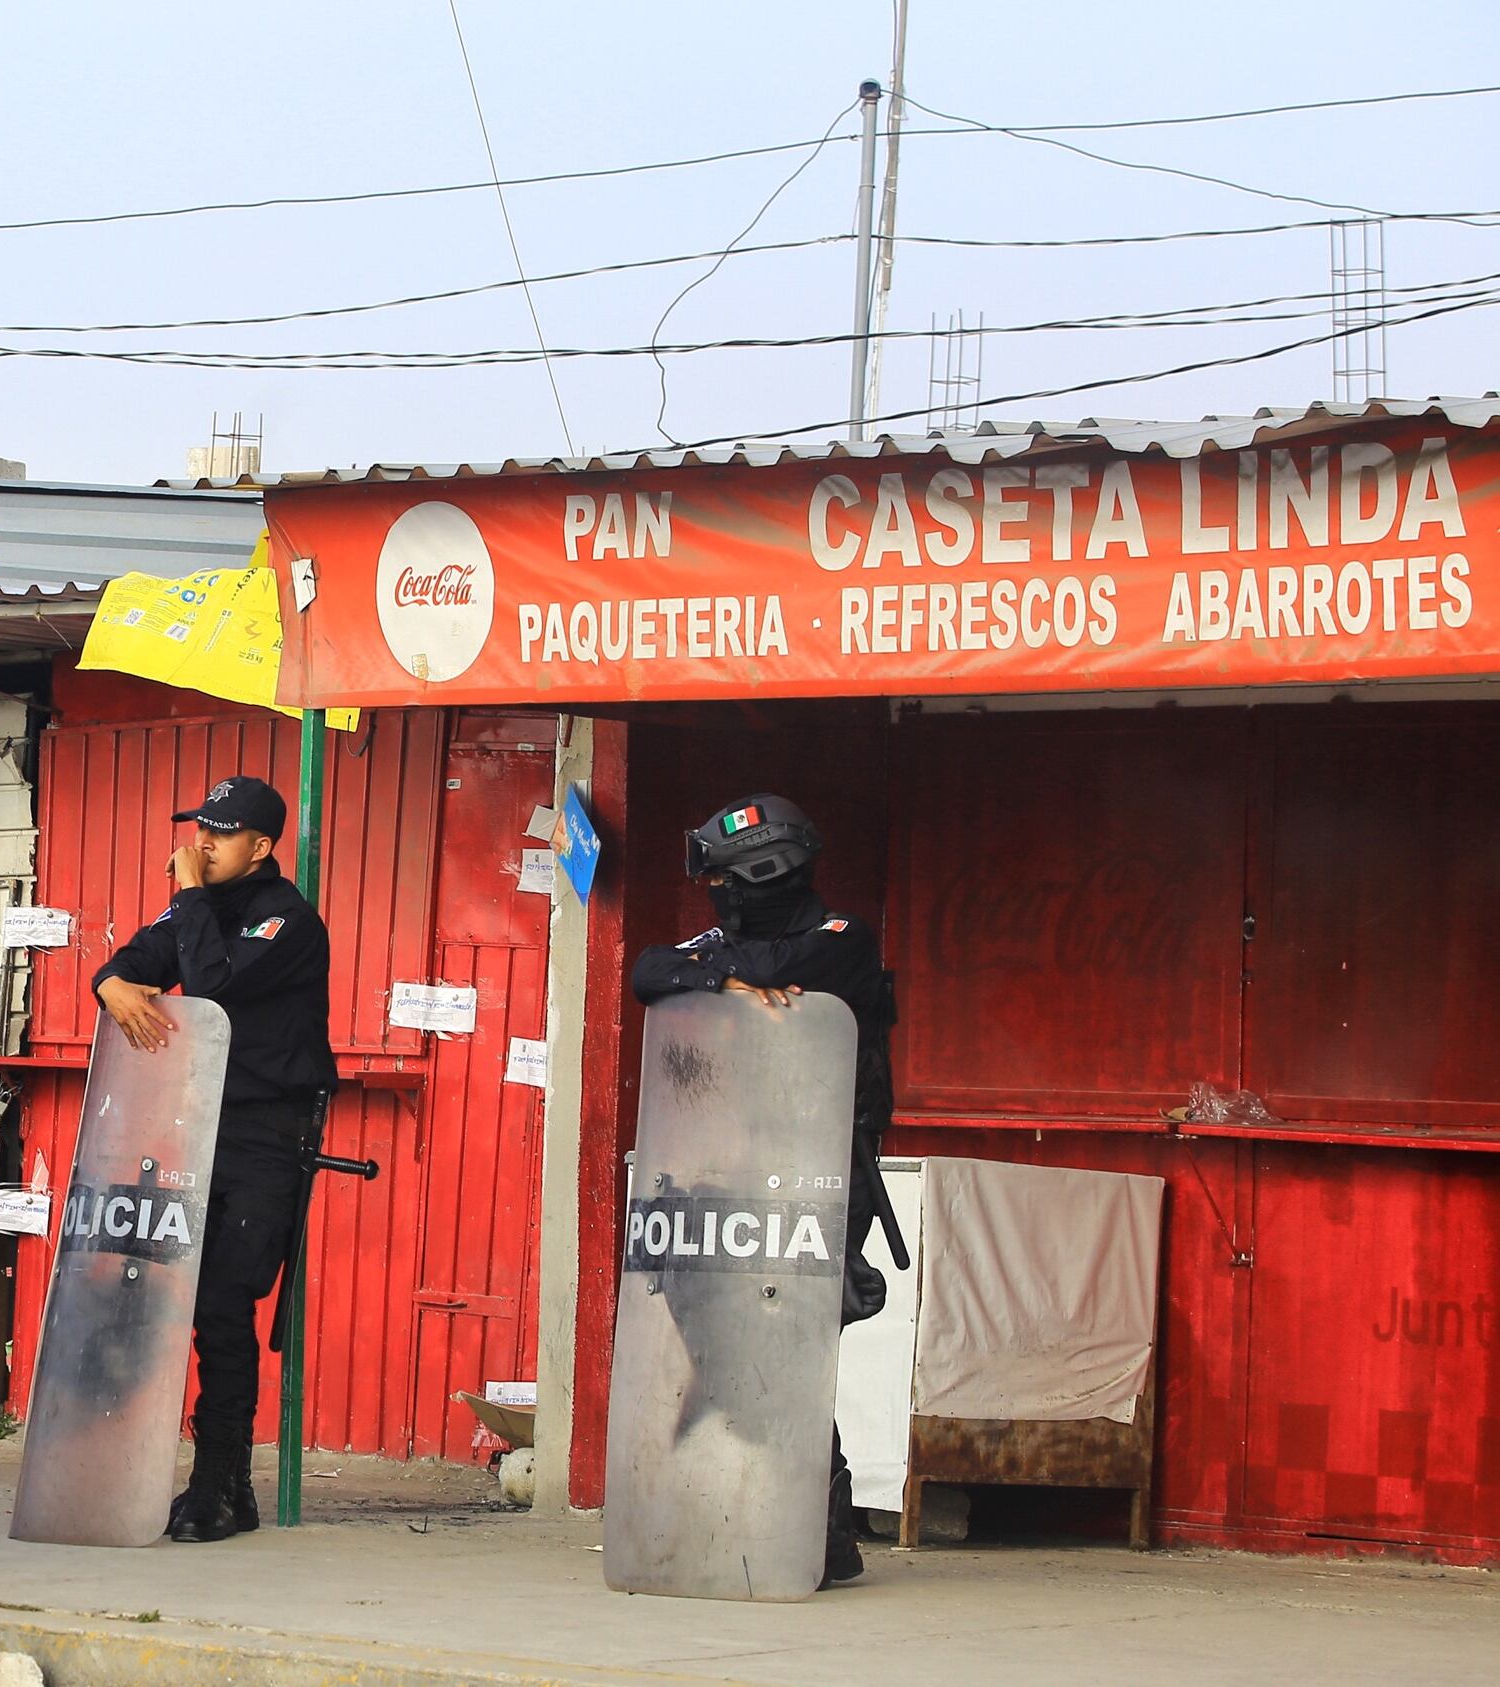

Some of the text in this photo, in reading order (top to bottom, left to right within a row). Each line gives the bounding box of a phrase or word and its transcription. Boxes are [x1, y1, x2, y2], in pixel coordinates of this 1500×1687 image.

[563, 491, 673, 562] PAN
[807, 437, 1467, 571] CASETA LINDA
[394, 564, 477, 607] Coca-Cola
[518, 552, 1473, 663] PAQUETERIA REFRESCOS ABARROTES
[627, 1211, 830, 1260] POLICIA
